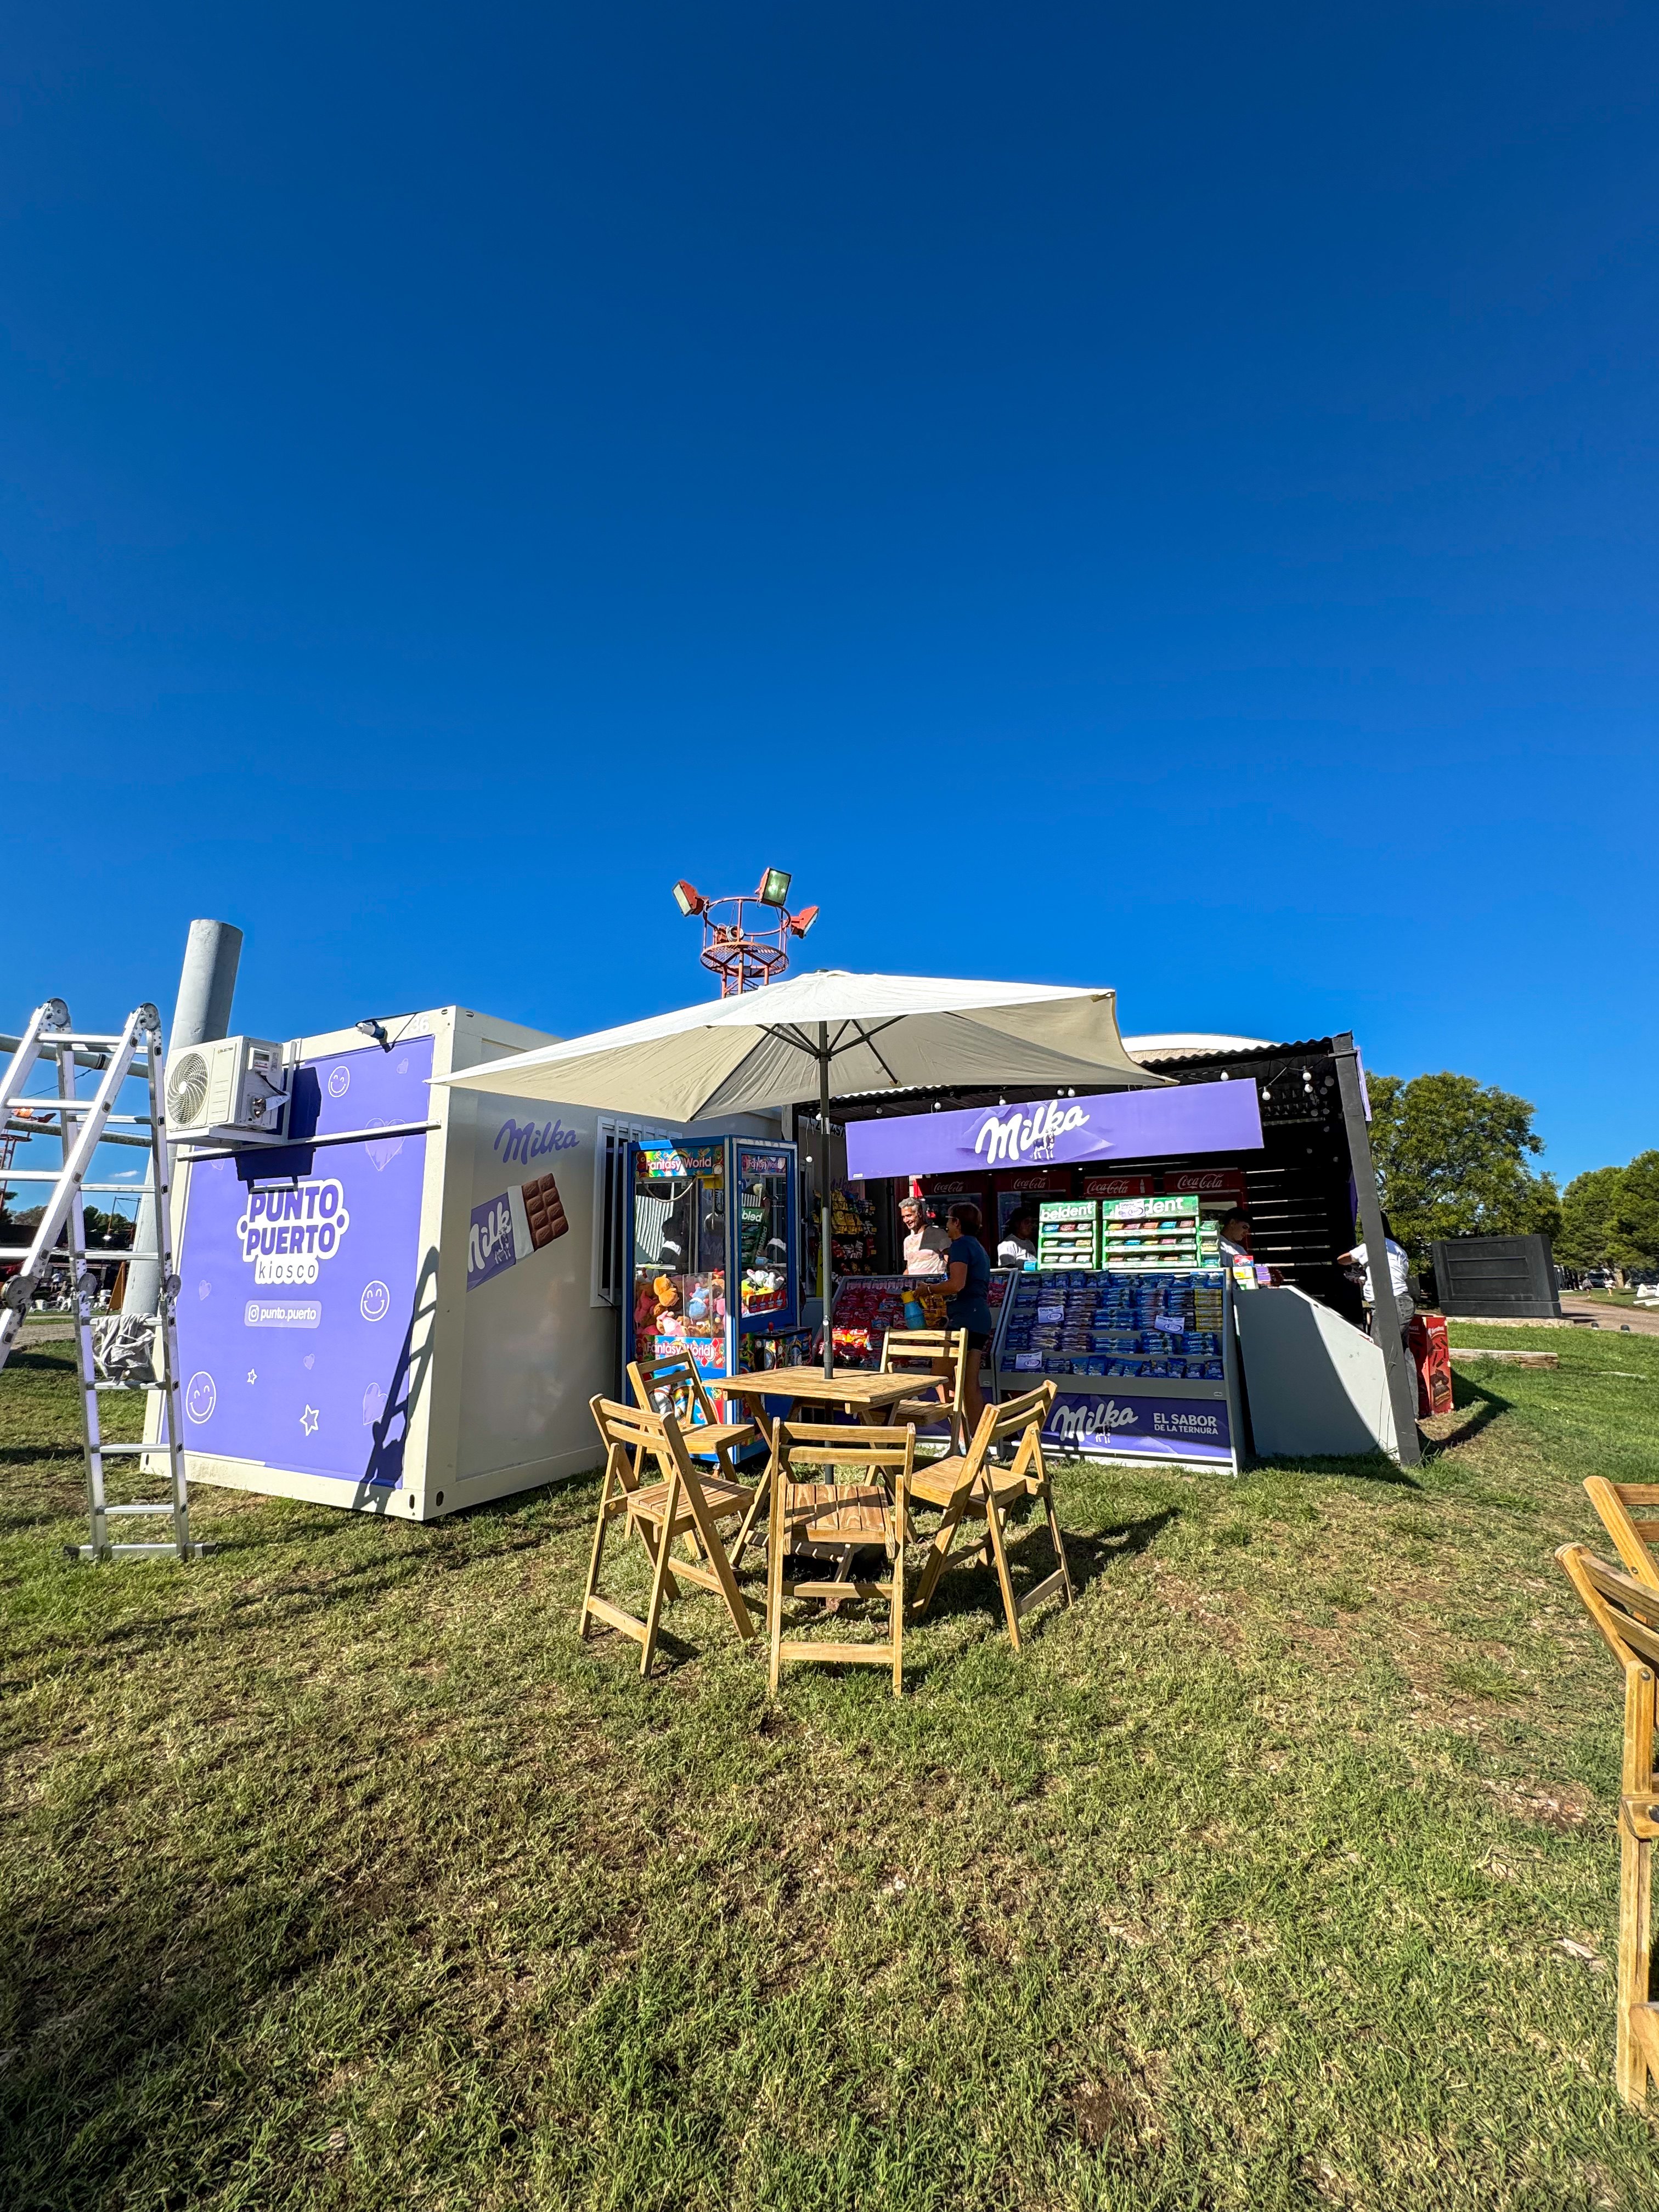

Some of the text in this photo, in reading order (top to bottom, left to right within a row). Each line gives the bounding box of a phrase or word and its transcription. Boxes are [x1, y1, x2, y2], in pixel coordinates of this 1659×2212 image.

[975, 1099, 1090, 1164] Milka
[494, 1119, 580, 1165] Milka
[646, 1156, 712, 1171] Fantasy World
[934, 1181, 964, 1193] Coca-Cola
[1013, 1177, 1047, 1190] Coca-Cola
[1084, 1180, 1130, 1195] Coca-Cola
[1177, 1173, 1224, 1190] Coca-Cola
[249, 1184, 338, 1223] PUNTO
[1041, 1202, 1093, 1220] beldent
[246, 1223, 336, 1256] PUERTO
[259, 1261, 315, 1279] kiosco
[260, 1307, 317, 1322] punto.puerto
[647, 1341, 682, 1355] Fantasy
[1051, 1400, 1138, 1442] Milka
[1153, 1413, 1217, 1427] EL SABOR
[1178, 1426, 1218, 1435] TERNURA
